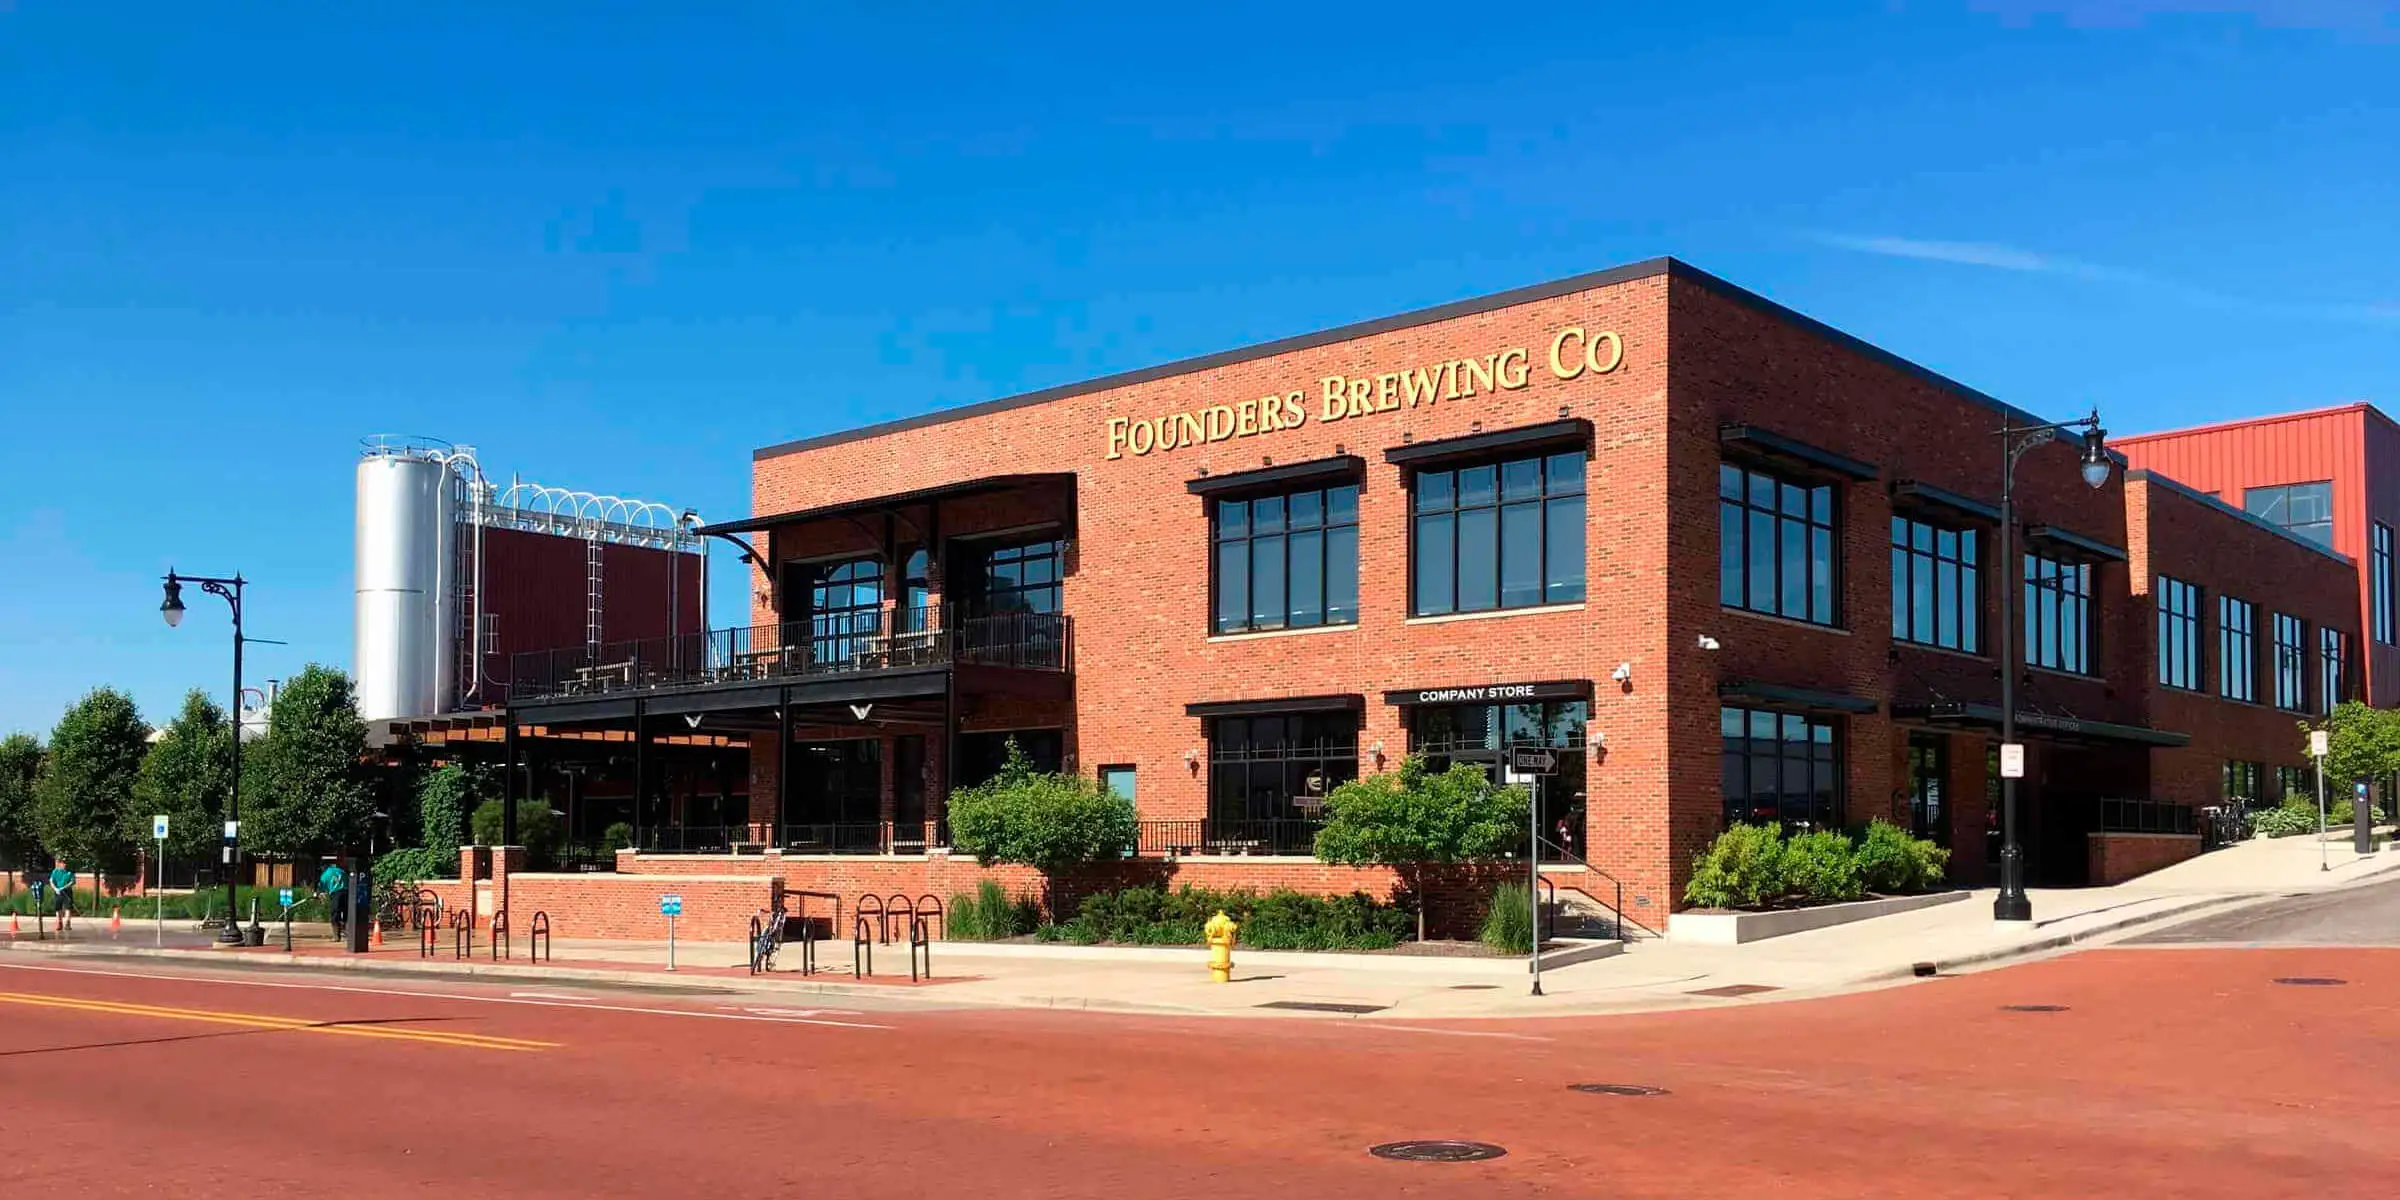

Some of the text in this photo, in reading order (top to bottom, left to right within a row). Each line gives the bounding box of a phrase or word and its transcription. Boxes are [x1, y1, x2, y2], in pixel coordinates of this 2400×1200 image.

[1105, 390, 1306, 459] FOUNDERS
[1319, 347, 1530, 422] BREWING
[1419, 685, 1535, 702] COMPANY STORE
[1519, 755, 1532, 766] ONE
[359, 872, 366, 881] P
